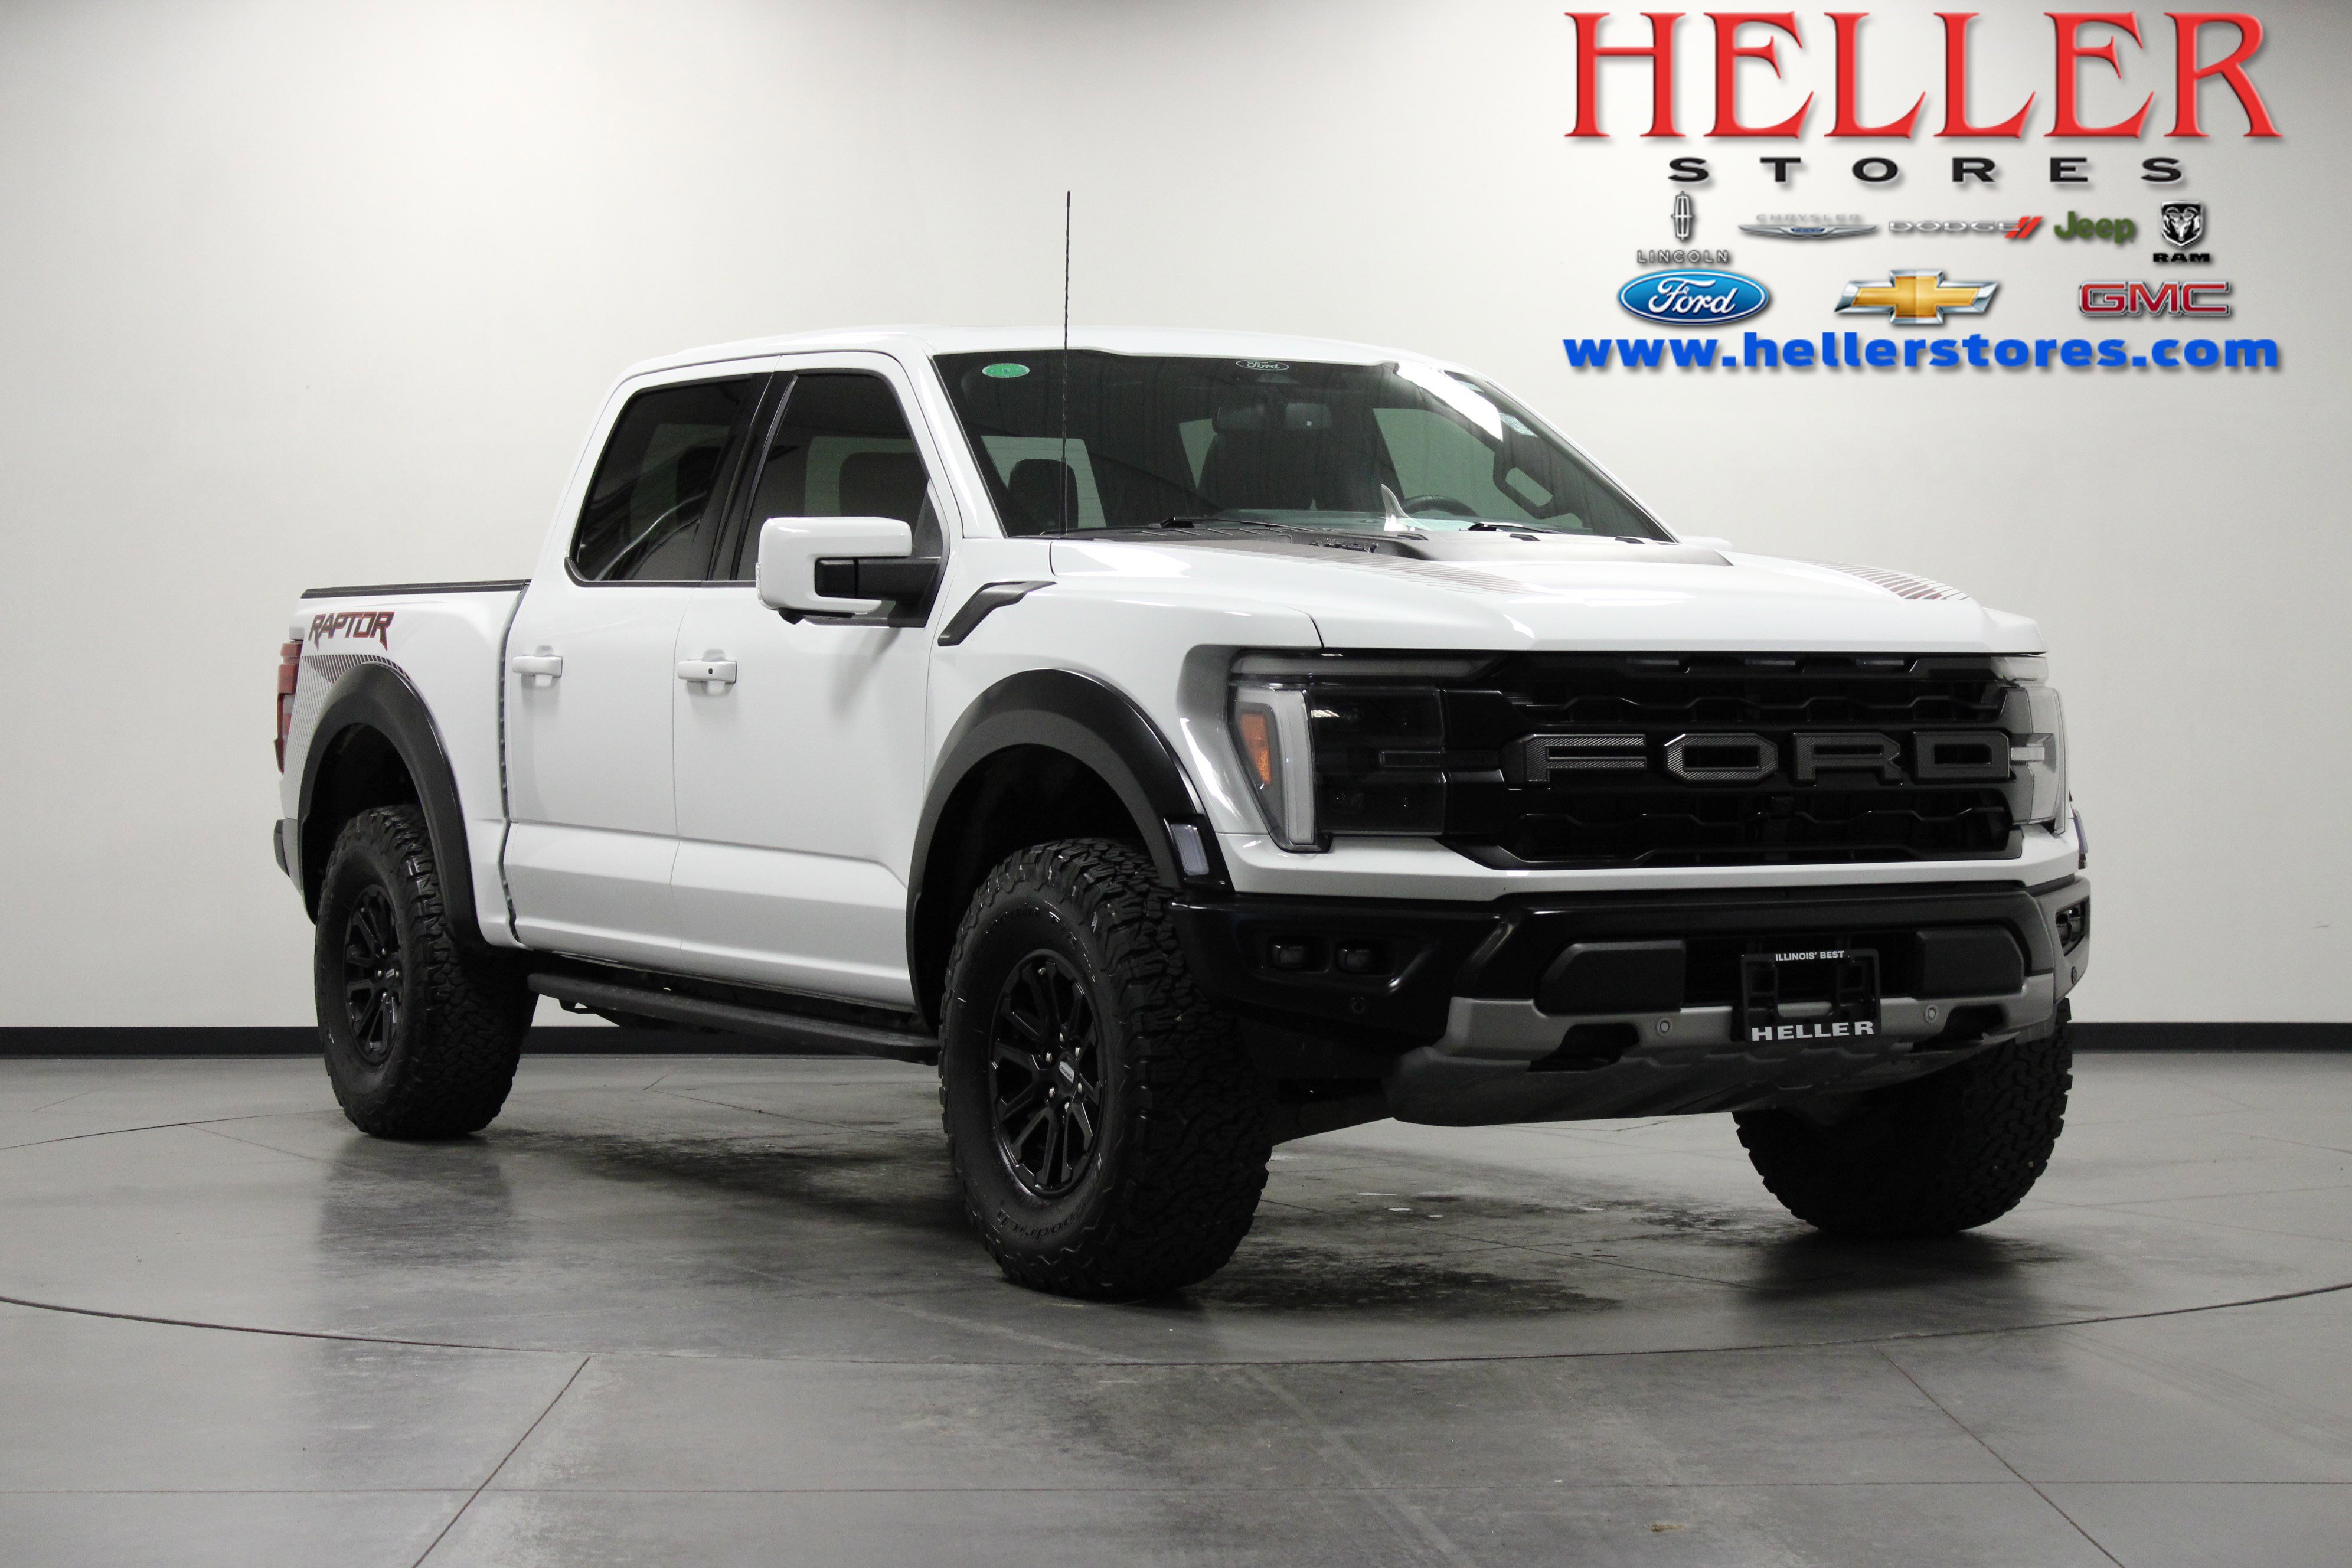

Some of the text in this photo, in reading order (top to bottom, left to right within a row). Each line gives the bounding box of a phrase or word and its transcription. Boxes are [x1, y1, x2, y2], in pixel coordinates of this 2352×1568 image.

[1247, 361, 1280, 369] Ford
[308, 612, 395, 651] RAPTOR
[1502, 731, 2015, 791] FORD
[1819, 950, 1844, 959] BEST
[1751, 1020, 1874, 1041] HELLER
